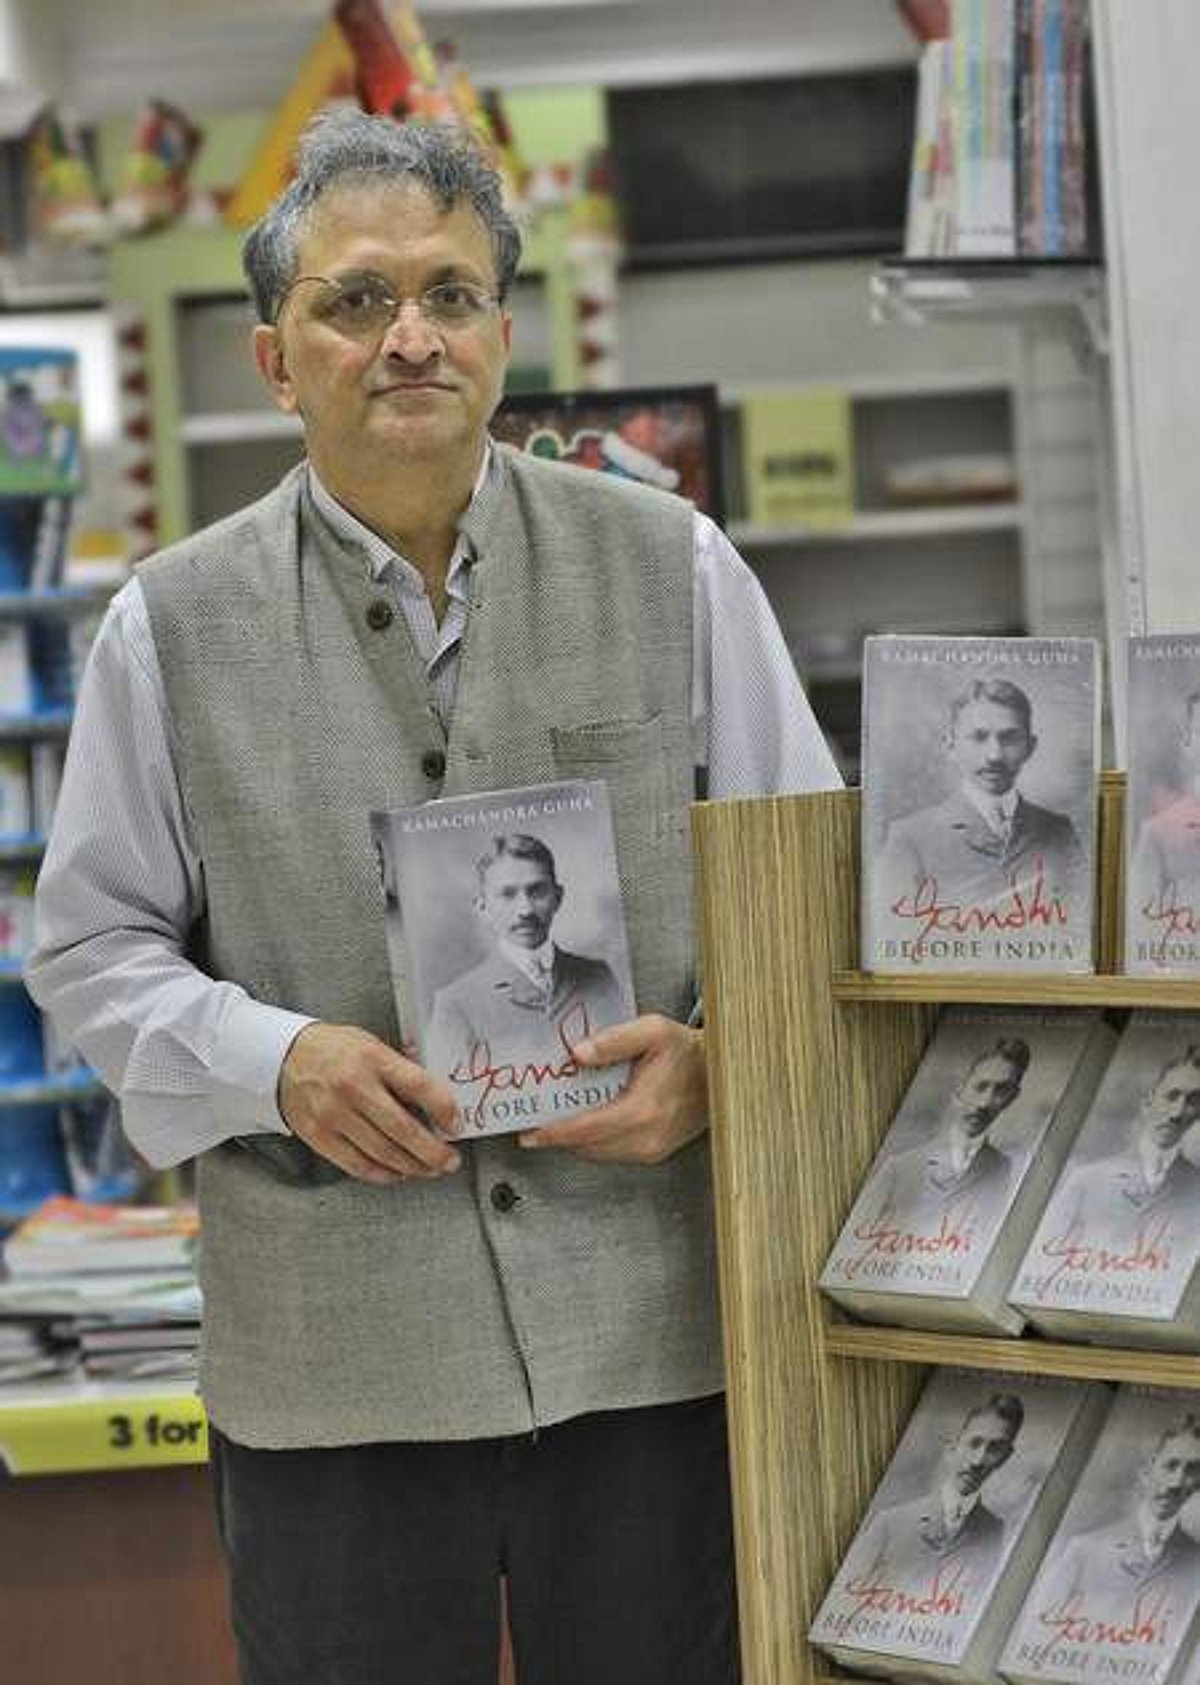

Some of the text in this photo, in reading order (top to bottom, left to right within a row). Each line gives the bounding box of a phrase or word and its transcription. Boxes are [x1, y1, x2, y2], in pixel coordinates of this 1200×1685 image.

[892, 854, 1067, 964] Gandhi
[884, 939, 1075, 960] BEFORE INDIA
[449, 1001, 590, 1130] Gand
[460, 1096, 540, 1124] EFORE
[109, 1415, 203, 1448] 3 for
